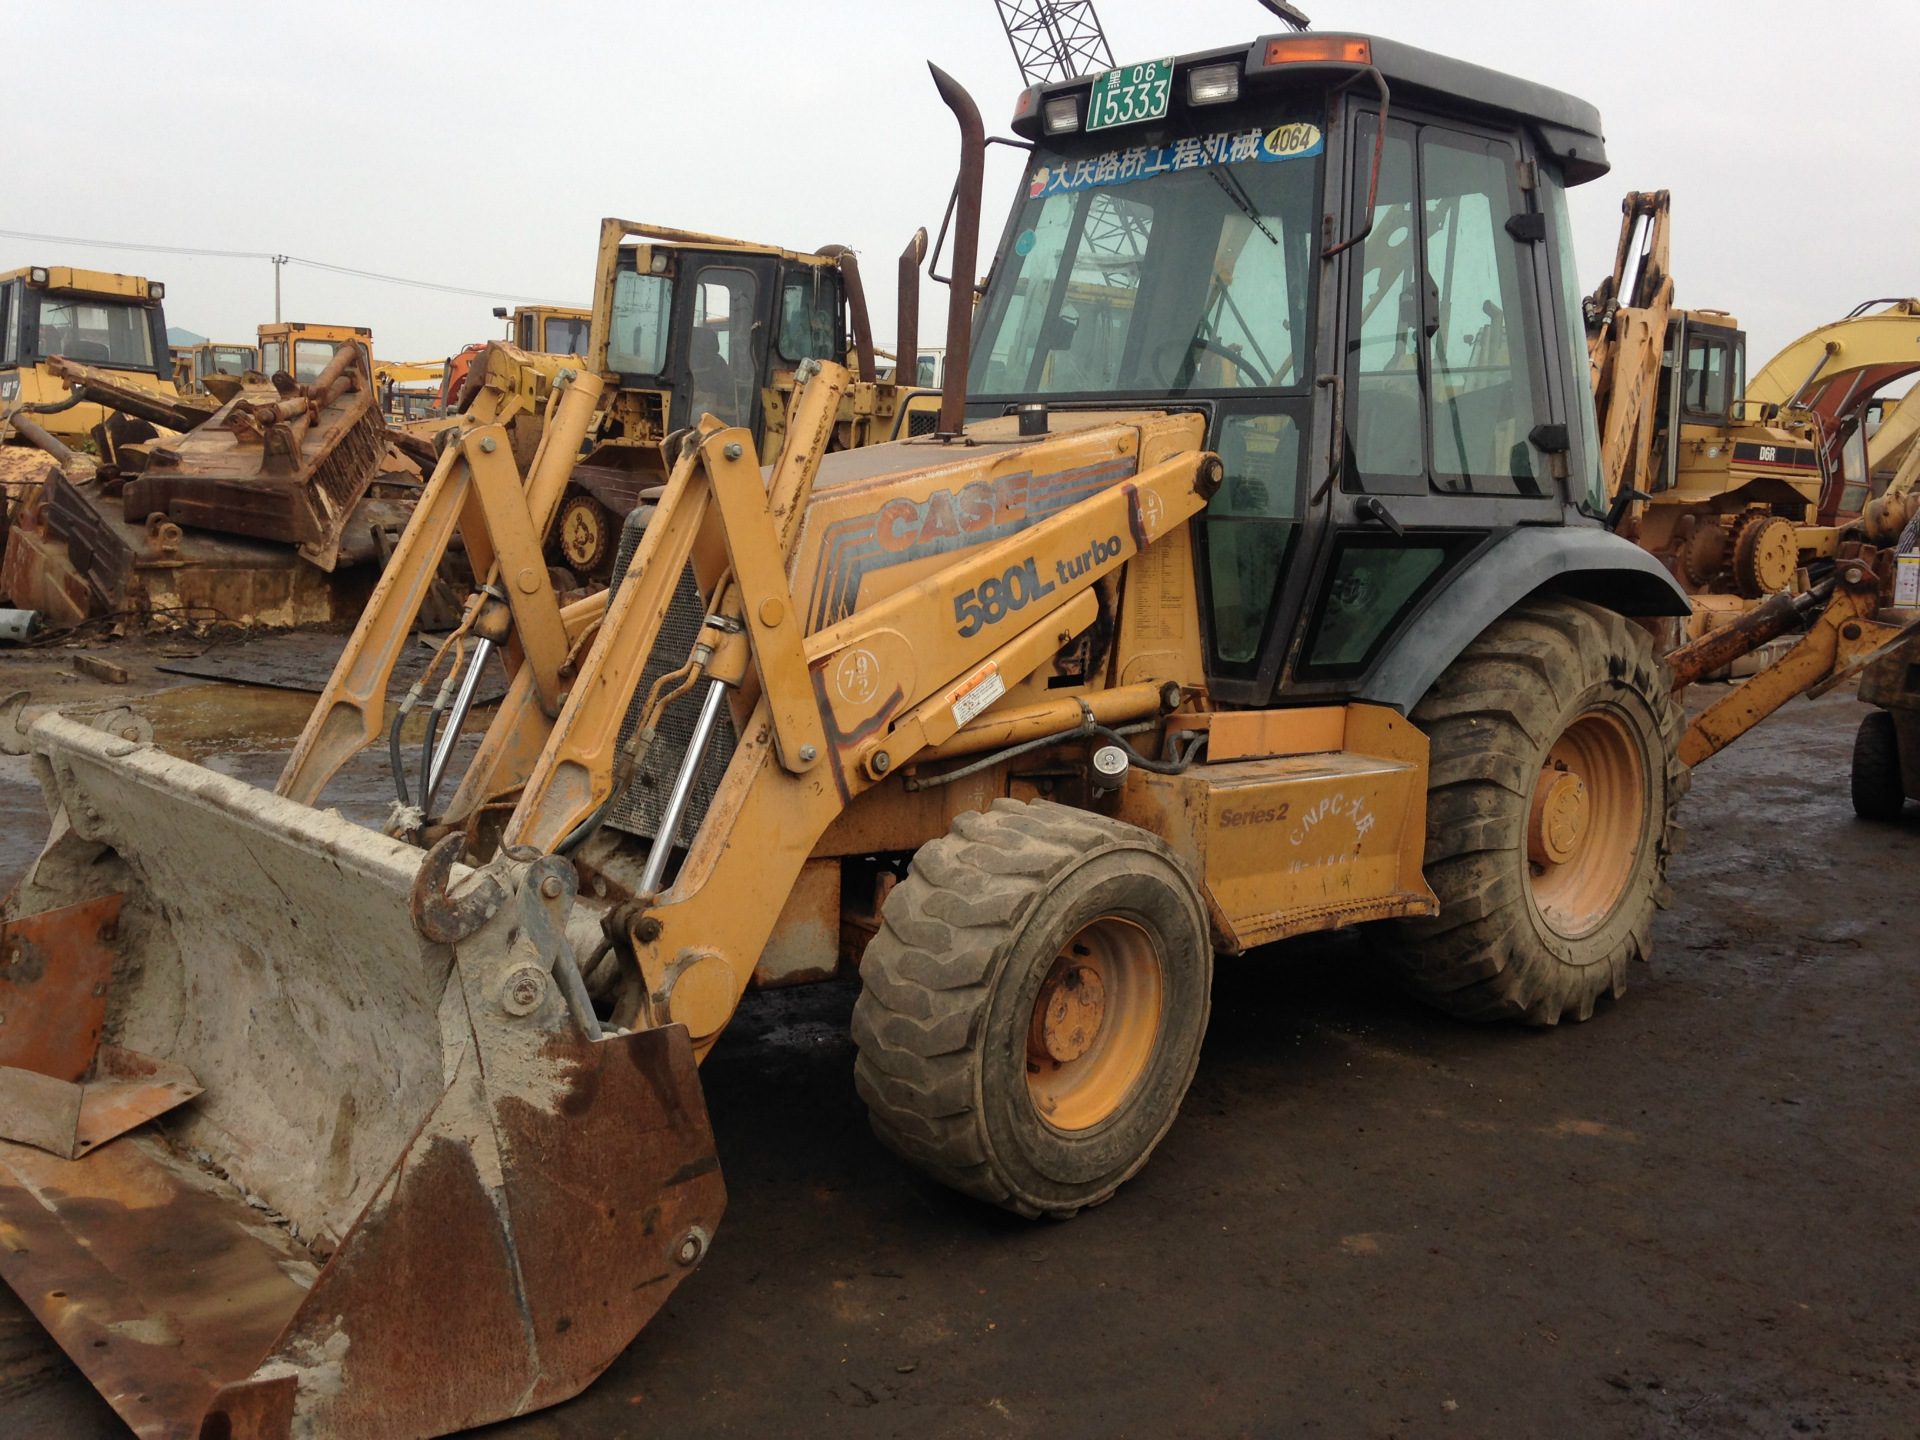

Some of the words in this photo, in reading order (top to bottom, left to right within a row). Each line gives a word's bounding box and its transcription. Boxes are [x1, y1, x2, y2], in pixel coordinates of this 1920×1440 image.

[1092, 79, 1168, 128] 15333
[1107, 69, 1122, 90] 黑
[1132, 62, 1157, 84] 06
[1048, 129, 1263, 192] 大庆路桥工程机械
[1268, 128, 1312, 154] 4064
[1759, 445, 1776, 461] D6R
[876, 472, 1031, 553] CASE
[953, 556, 1057, 639] 580L
[1056, 534, 1122, 586] turbo
